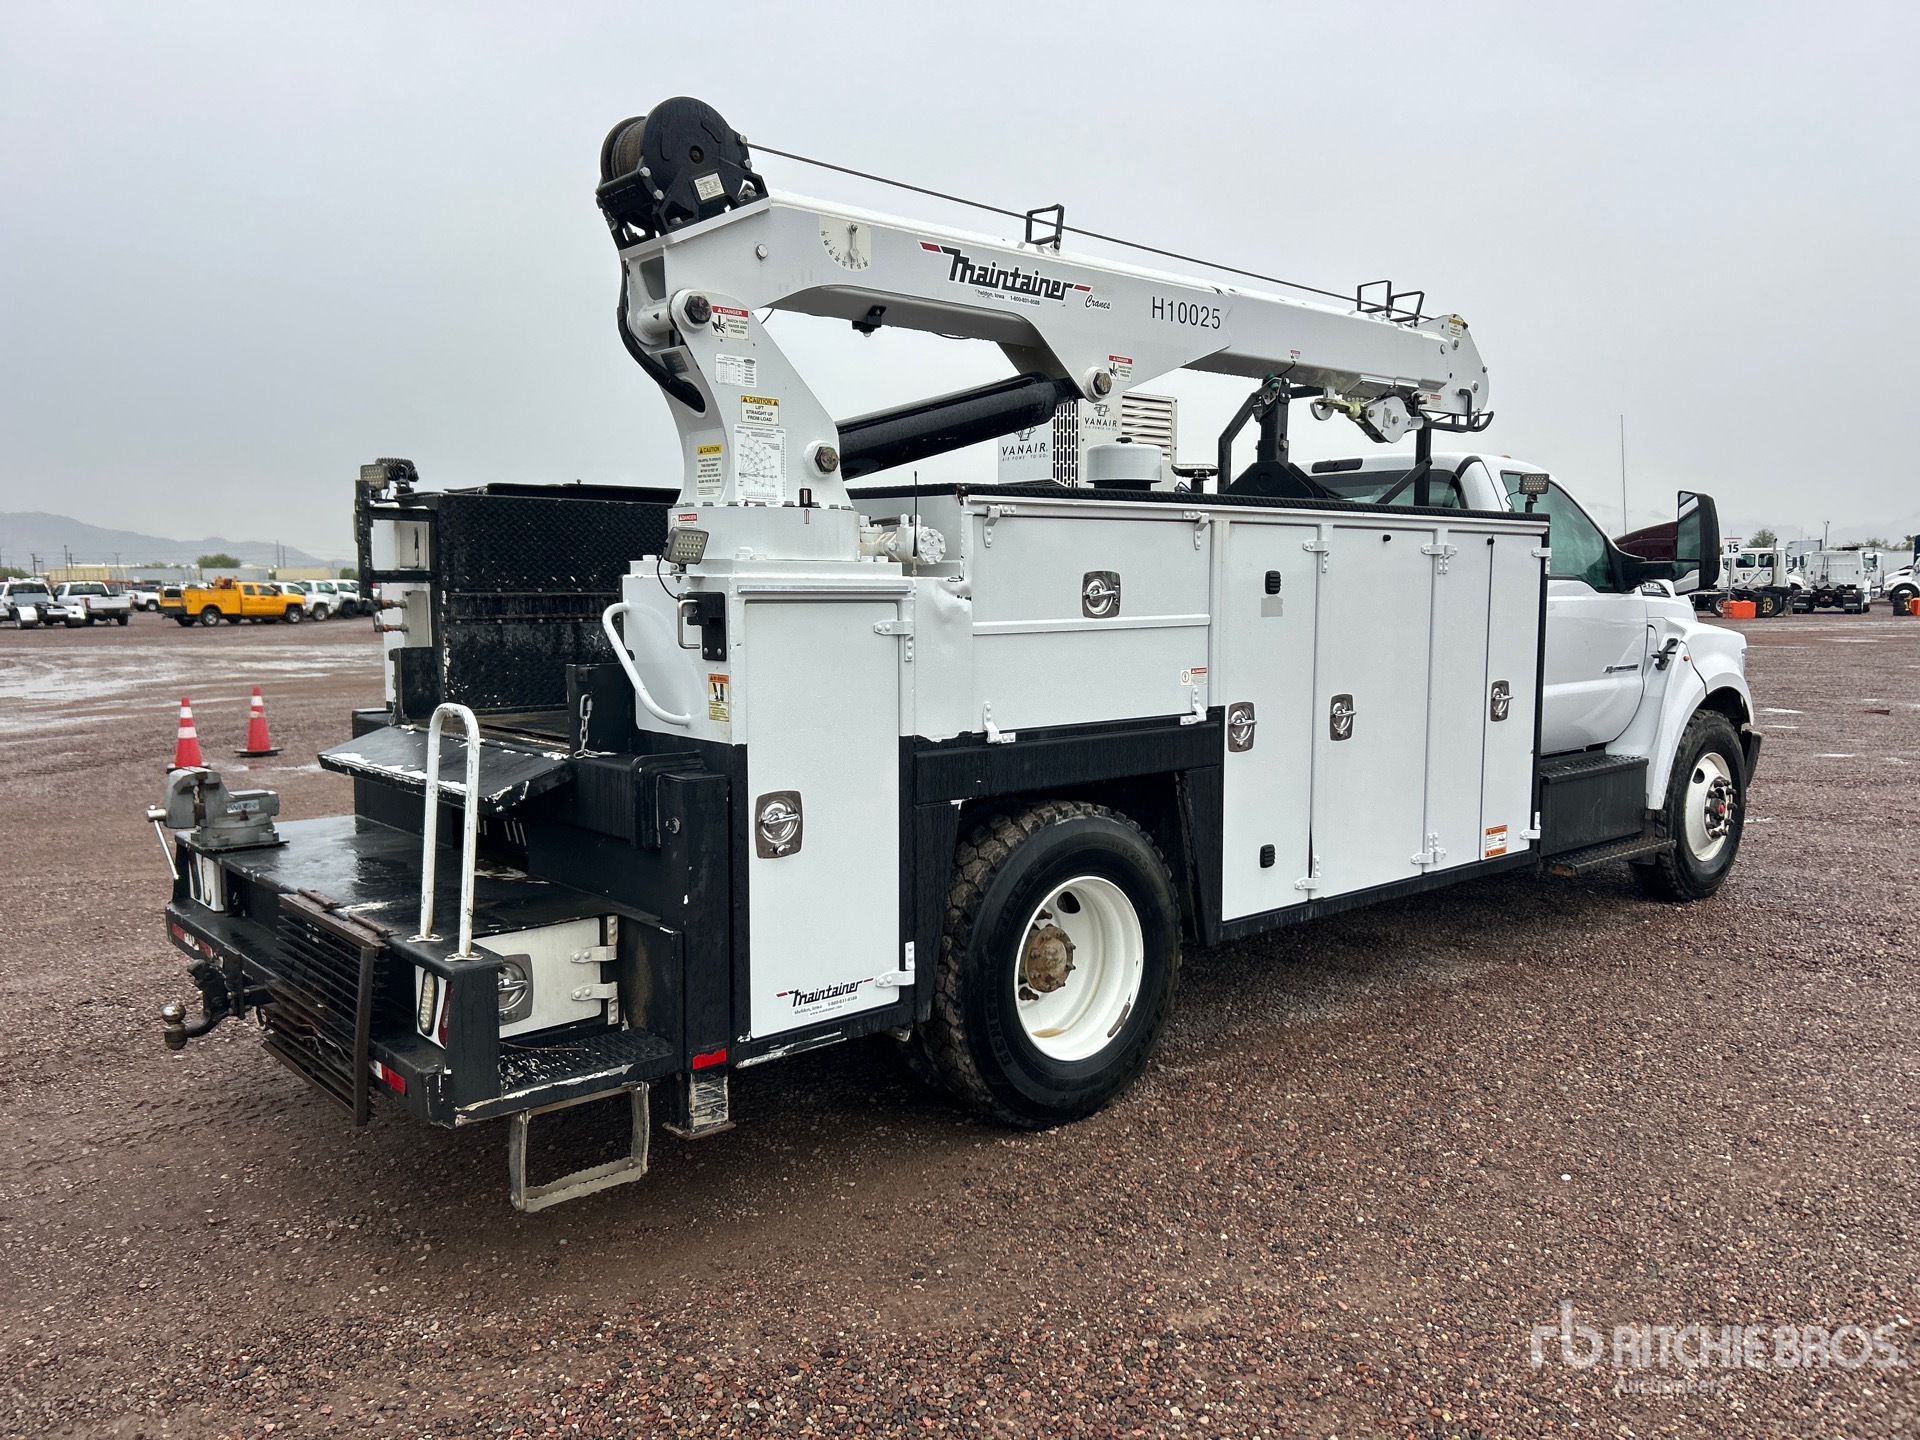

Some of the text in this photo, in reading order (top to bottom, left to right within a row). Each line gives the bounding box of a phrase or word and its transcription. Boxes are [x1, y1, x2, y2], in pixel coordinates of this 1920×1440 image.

[940, 245, 1075, 301] Maintainer
[1085, 294, 1111, 310] Cranes
[722, 308, 743, 316] DANGER
[1151, 296, 1221, 330] H10025
[748, 396, 772, 406] CAUTION
[1085, 417, 1118, 428] VANAIR
[1001, 442, 1046, 457] VANAIR
[1727, 544, 1739, 554] 15
[787, 979, 863, 1008] Maintainer
